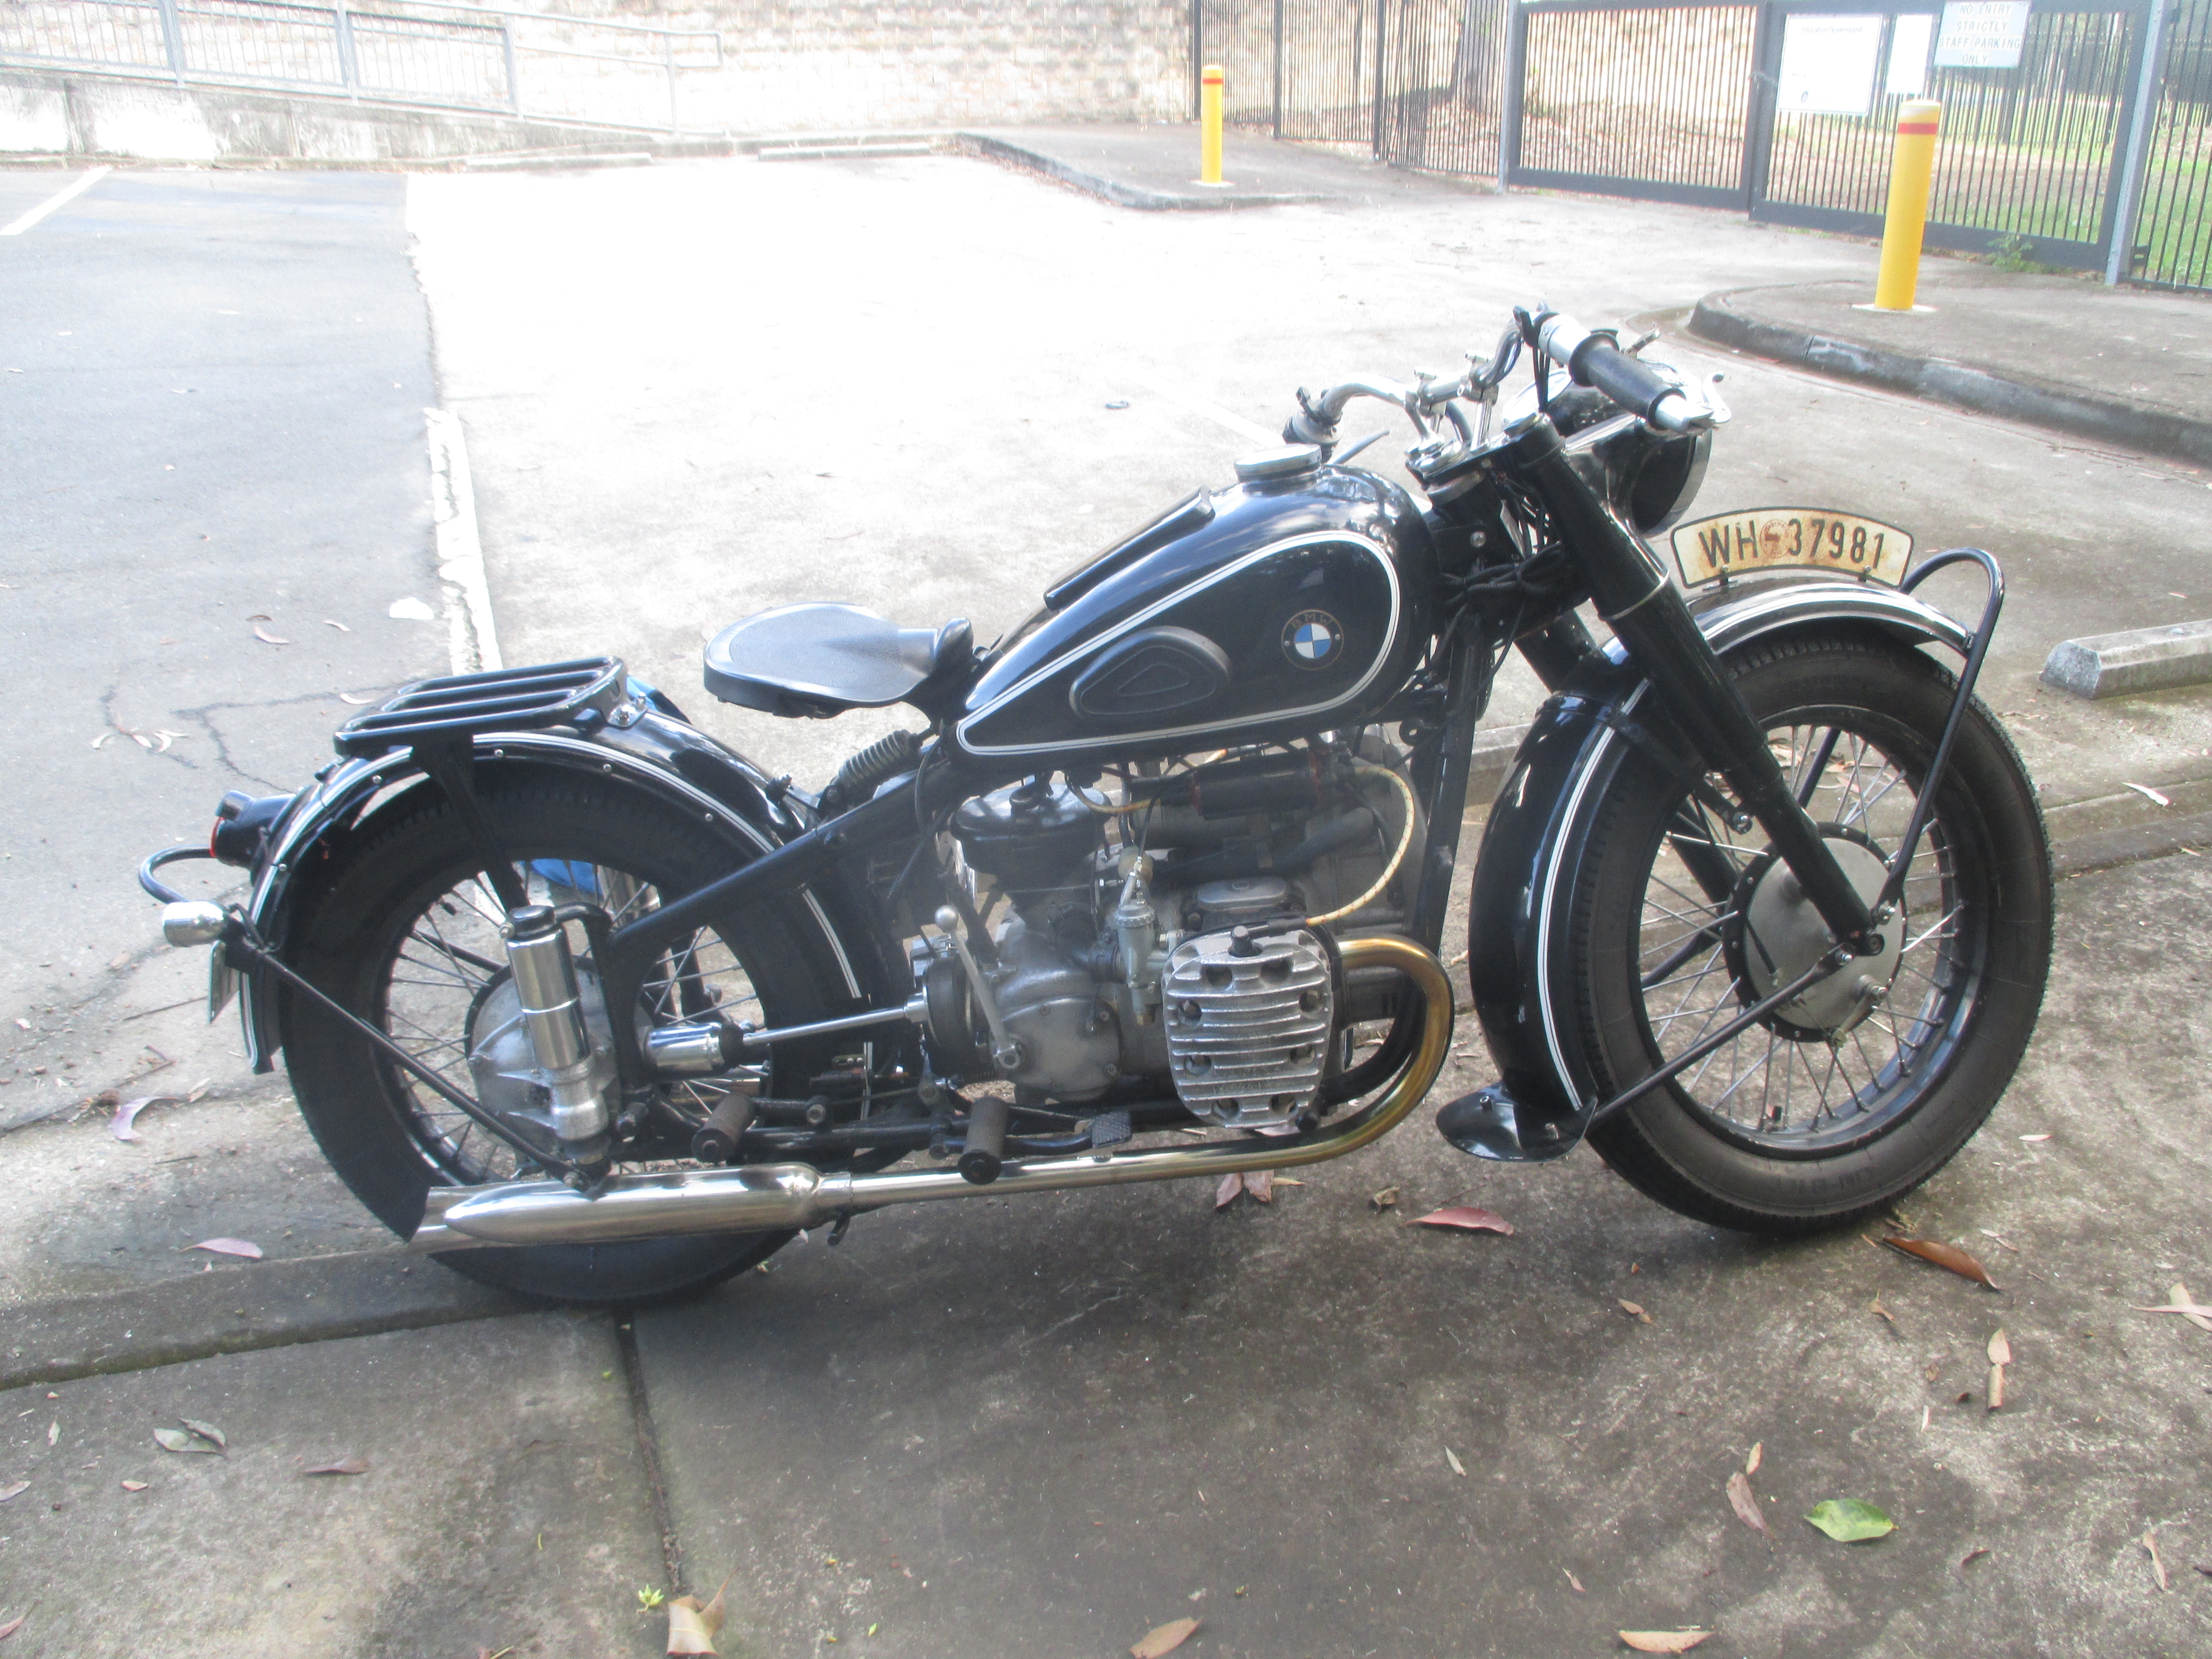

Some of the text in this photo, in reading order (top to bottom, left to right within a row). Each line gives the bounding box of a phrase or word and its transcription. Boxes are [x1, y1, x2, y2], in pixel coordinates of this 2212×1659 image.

[1960, 4, 2011, 15] NO ENTRY
[1957, 21, 2008, 32] STRICTLY
[1939, 37, 2021, 48] STAFF PARKING
[1962, 53, 1989, 64] ONLY
[1698, 520, 1758, 568] WH
[1788, 518, 1884, 569] 37981
[1291, 613, 1333, 628] BMW
